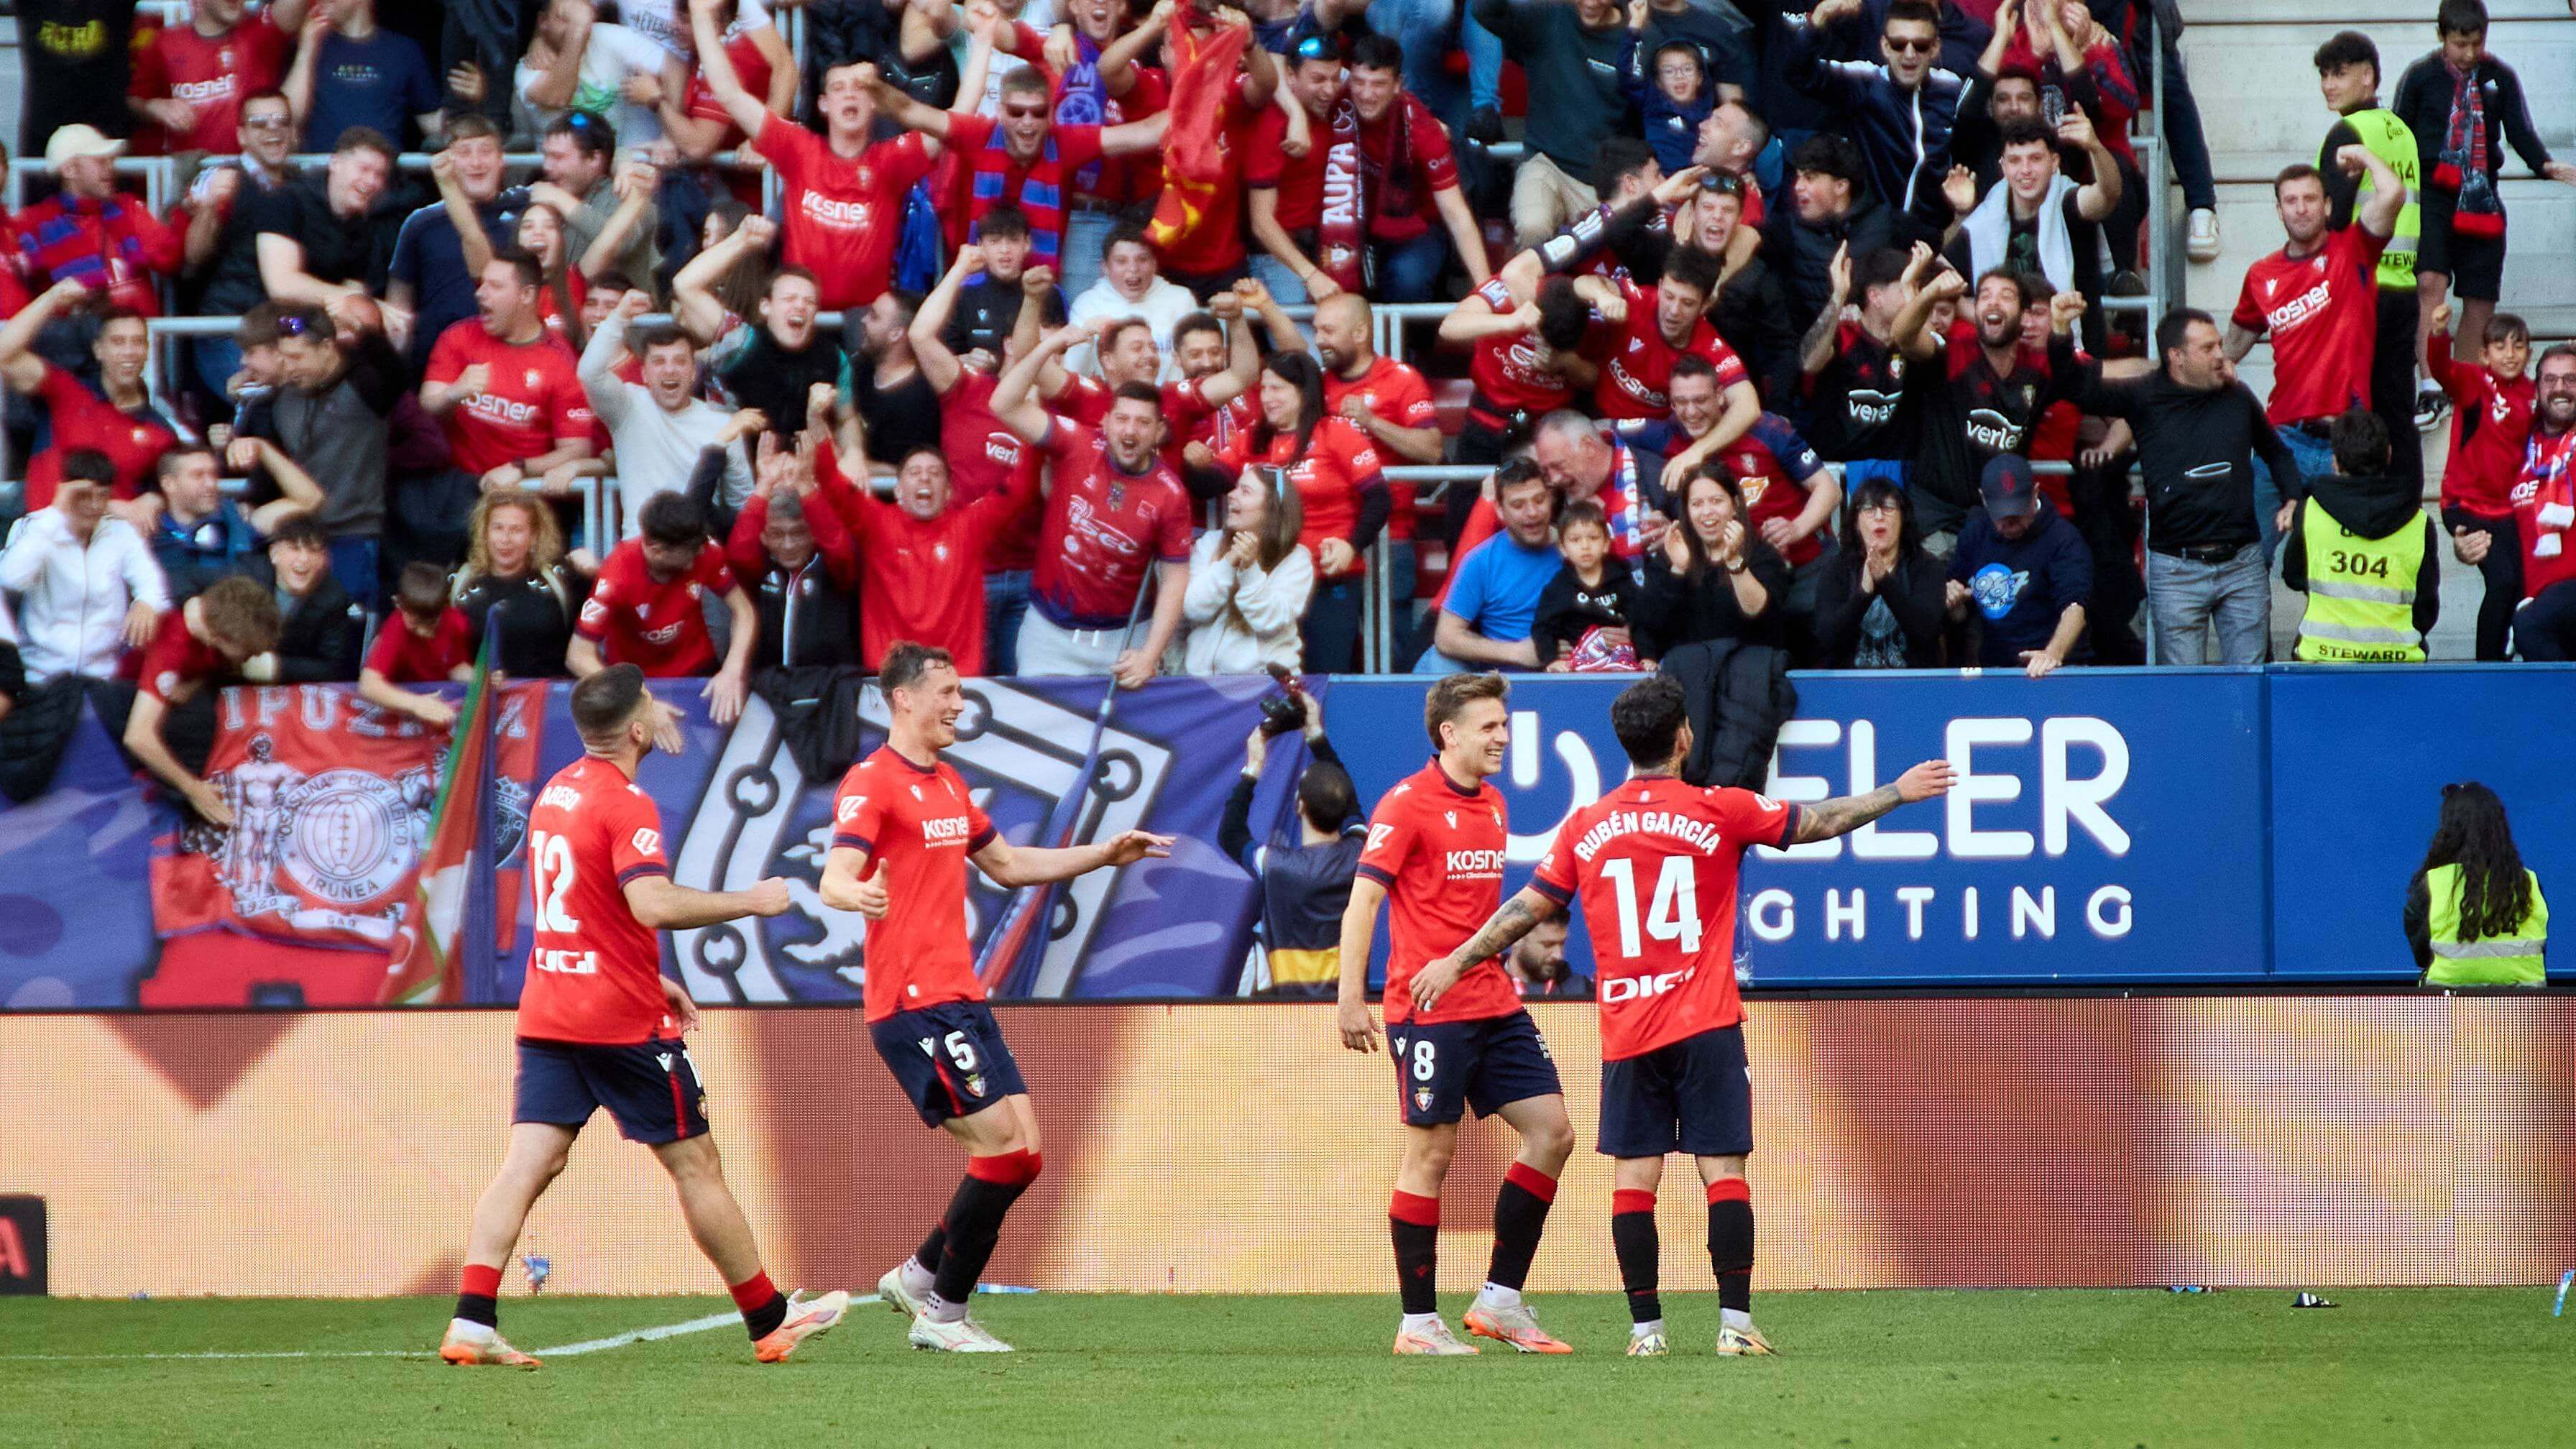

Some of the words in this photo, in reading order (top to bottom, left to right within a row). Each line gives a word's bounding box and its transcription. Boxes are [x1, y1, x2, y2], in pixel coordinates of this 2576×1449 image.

[1322, 142, 1356, 225] AUPA
[2330, 550, 2388, 579] 304
[2319, 643, 2406, 661] STEWARD
[1573, 810, 1639, 862] RUBÉN
[1642, 811, 1721, 856] GARCÍA
[530, 830, 579, 933] 12
[1600, 855, 1703, 958] 14
[944, 1030, 975, 1070] 5
[1414, 1040, 1435, 1081] 8
